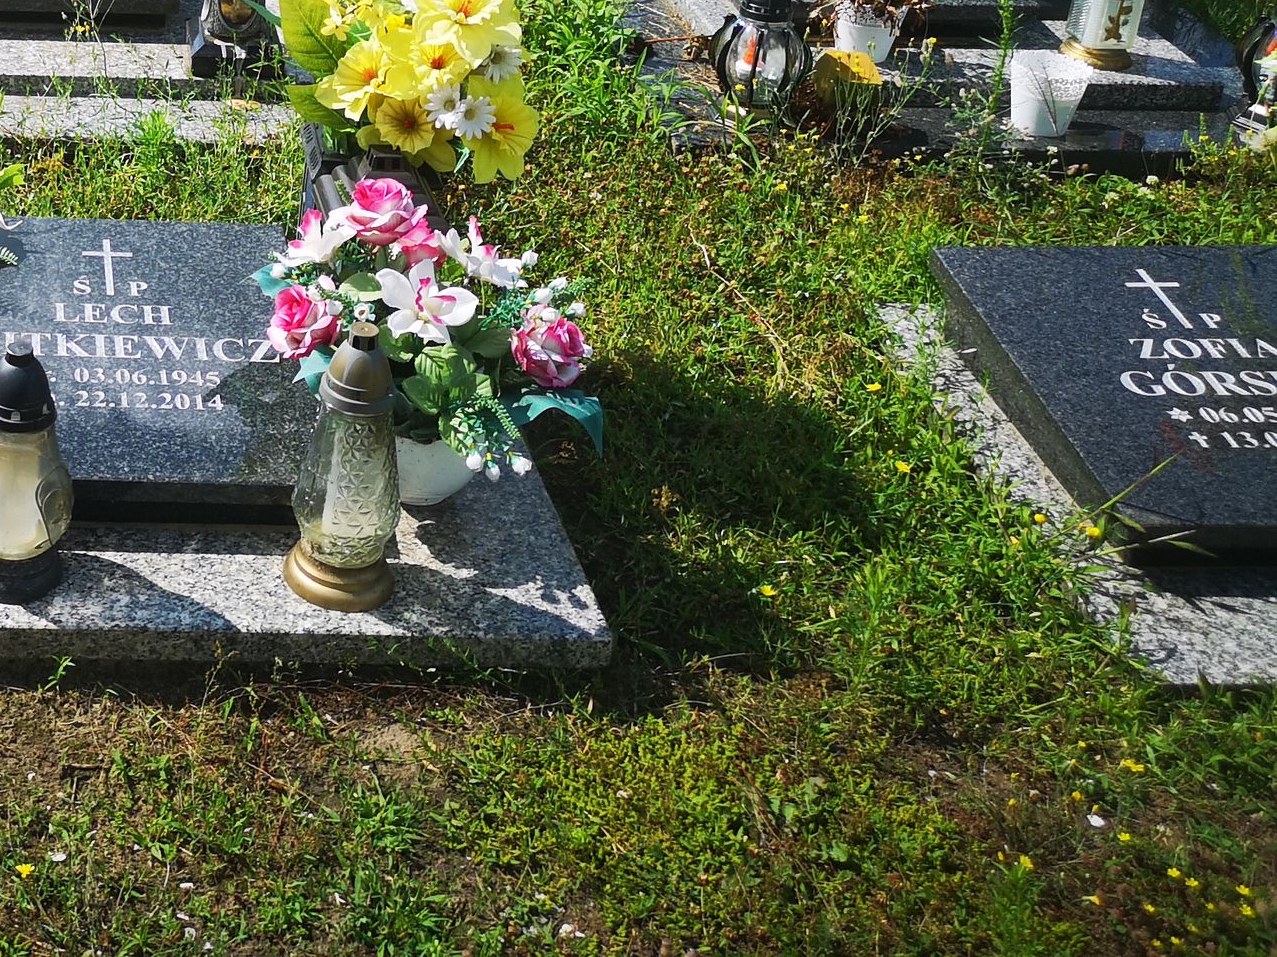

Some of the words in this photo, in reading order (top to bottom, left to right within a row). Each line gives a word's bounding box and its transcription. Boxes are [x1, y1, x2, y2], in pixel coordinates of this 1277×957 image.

[129, 280, 149, 297] P
[53, 302, 174, 325] LECH
[1141, 308, 1168, 330] Ś
[1198, 313, 1222, 329] P
[1128, 337, 1277, 359] ZOFIA
[74, 367, 222, 387] 03.06.1945
[1119, 363, 1277, 397] GÓRS
[75, 391, 225, 411] 22.12.2014
